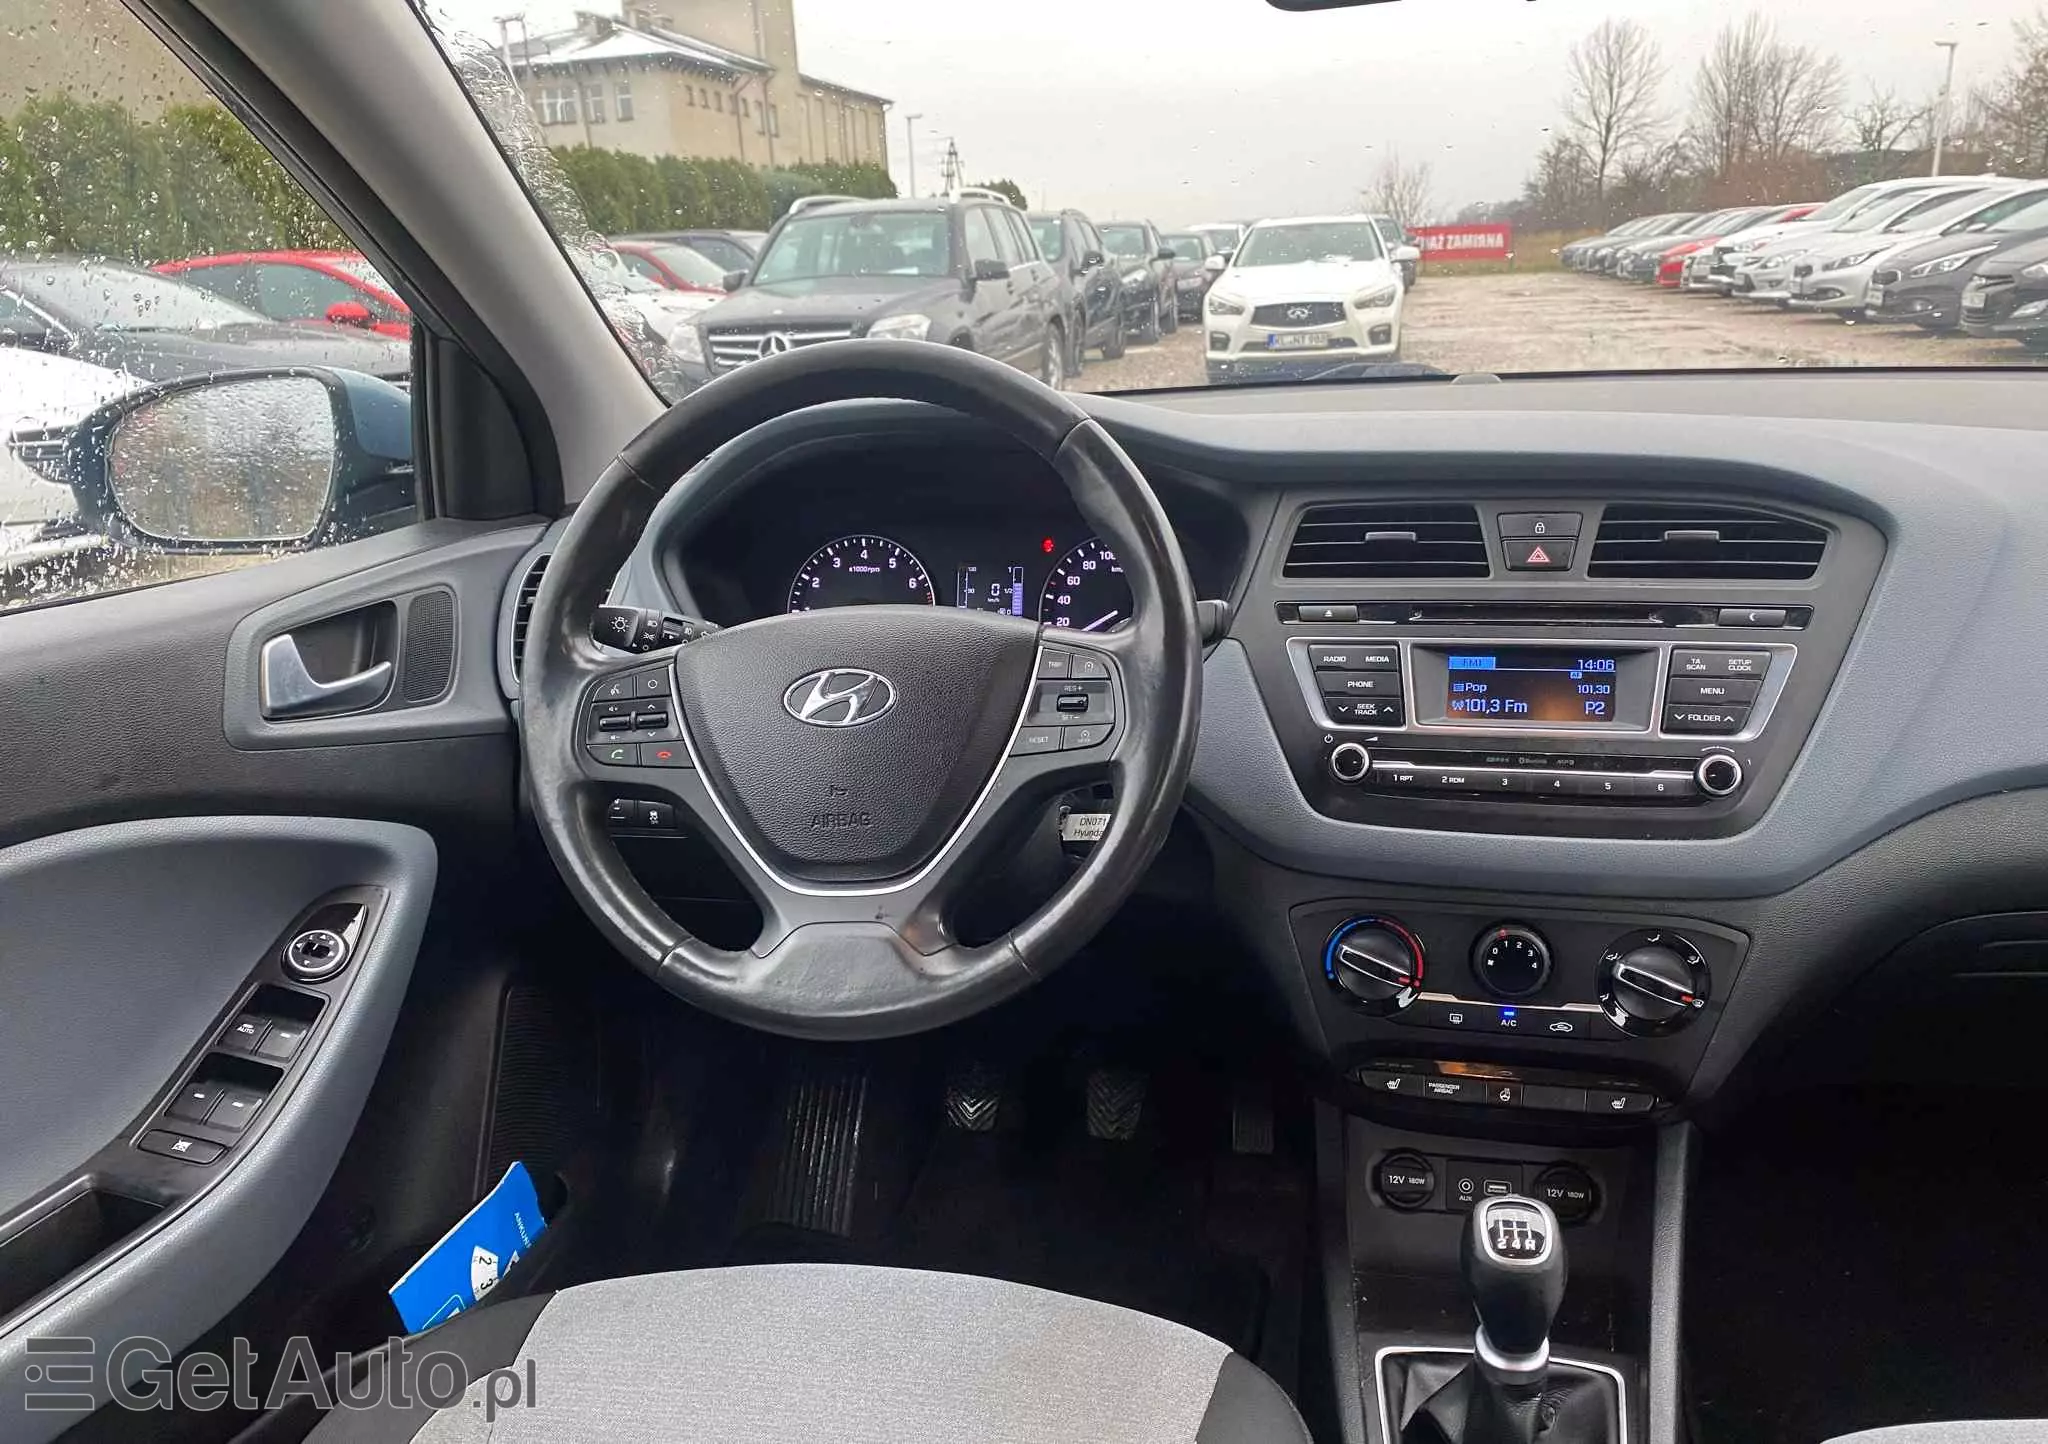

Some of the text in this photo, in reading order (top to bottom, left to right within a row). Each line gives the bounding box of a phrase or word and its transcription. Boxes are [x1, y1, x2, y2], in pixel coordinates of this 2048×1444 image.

[860, 549, 868, 559] 4
[832, 557, 841, 568] 3
[888, 558, 897, 569] 5
[1082, 560, 1097, 570] 80
[811, 577, 820, 588] 2
[908, 577, 917, 589] 6
[1066, 576, 1081, 586] 60
[990, 583, 1000, 596] 0
[1057, 595, 1071, 605] 40
[1056, 617, 1070, 627] 20
[1323, 655, 1347, 663] RADIO
[1365, 655, 1390, 663] MEDIA
[1577, 659, 1615, 671] 14:06
[1465, 682, 1488, 694] Pop
[1700, 687, 1725, 695] MENU
[1504, 700, 1528, 713] Fm
[1584, 701, 1605, 715] P2
[1687, 713, 1721, 722] FOLDER
[1393, 774, 1398, 782] 1
[1502, 778, 1508, 786] 3
[1553, 780, 1561, 788] 4
[1604, 782, 1612, 790] 5
[1657, 784, 1665, 792] 6
[1073, 829, 1104, 837] Hyunda
[1503, 940, 1508, 948] 1
[1516, 941, 1522, 949] 2
[1492, 947, 1498, 955] 0
[1527, 949, 1534, 957] 3
[1388, 1174, 1425, 1185] 12V 180W
[1547, 1188, 1585, 1199] 12V 180W
[1497, 1238, 1536, 1251] 2 4 R
[478, 1255, 492, 1265] 2
[480, 1278, 494, 1290] 3
